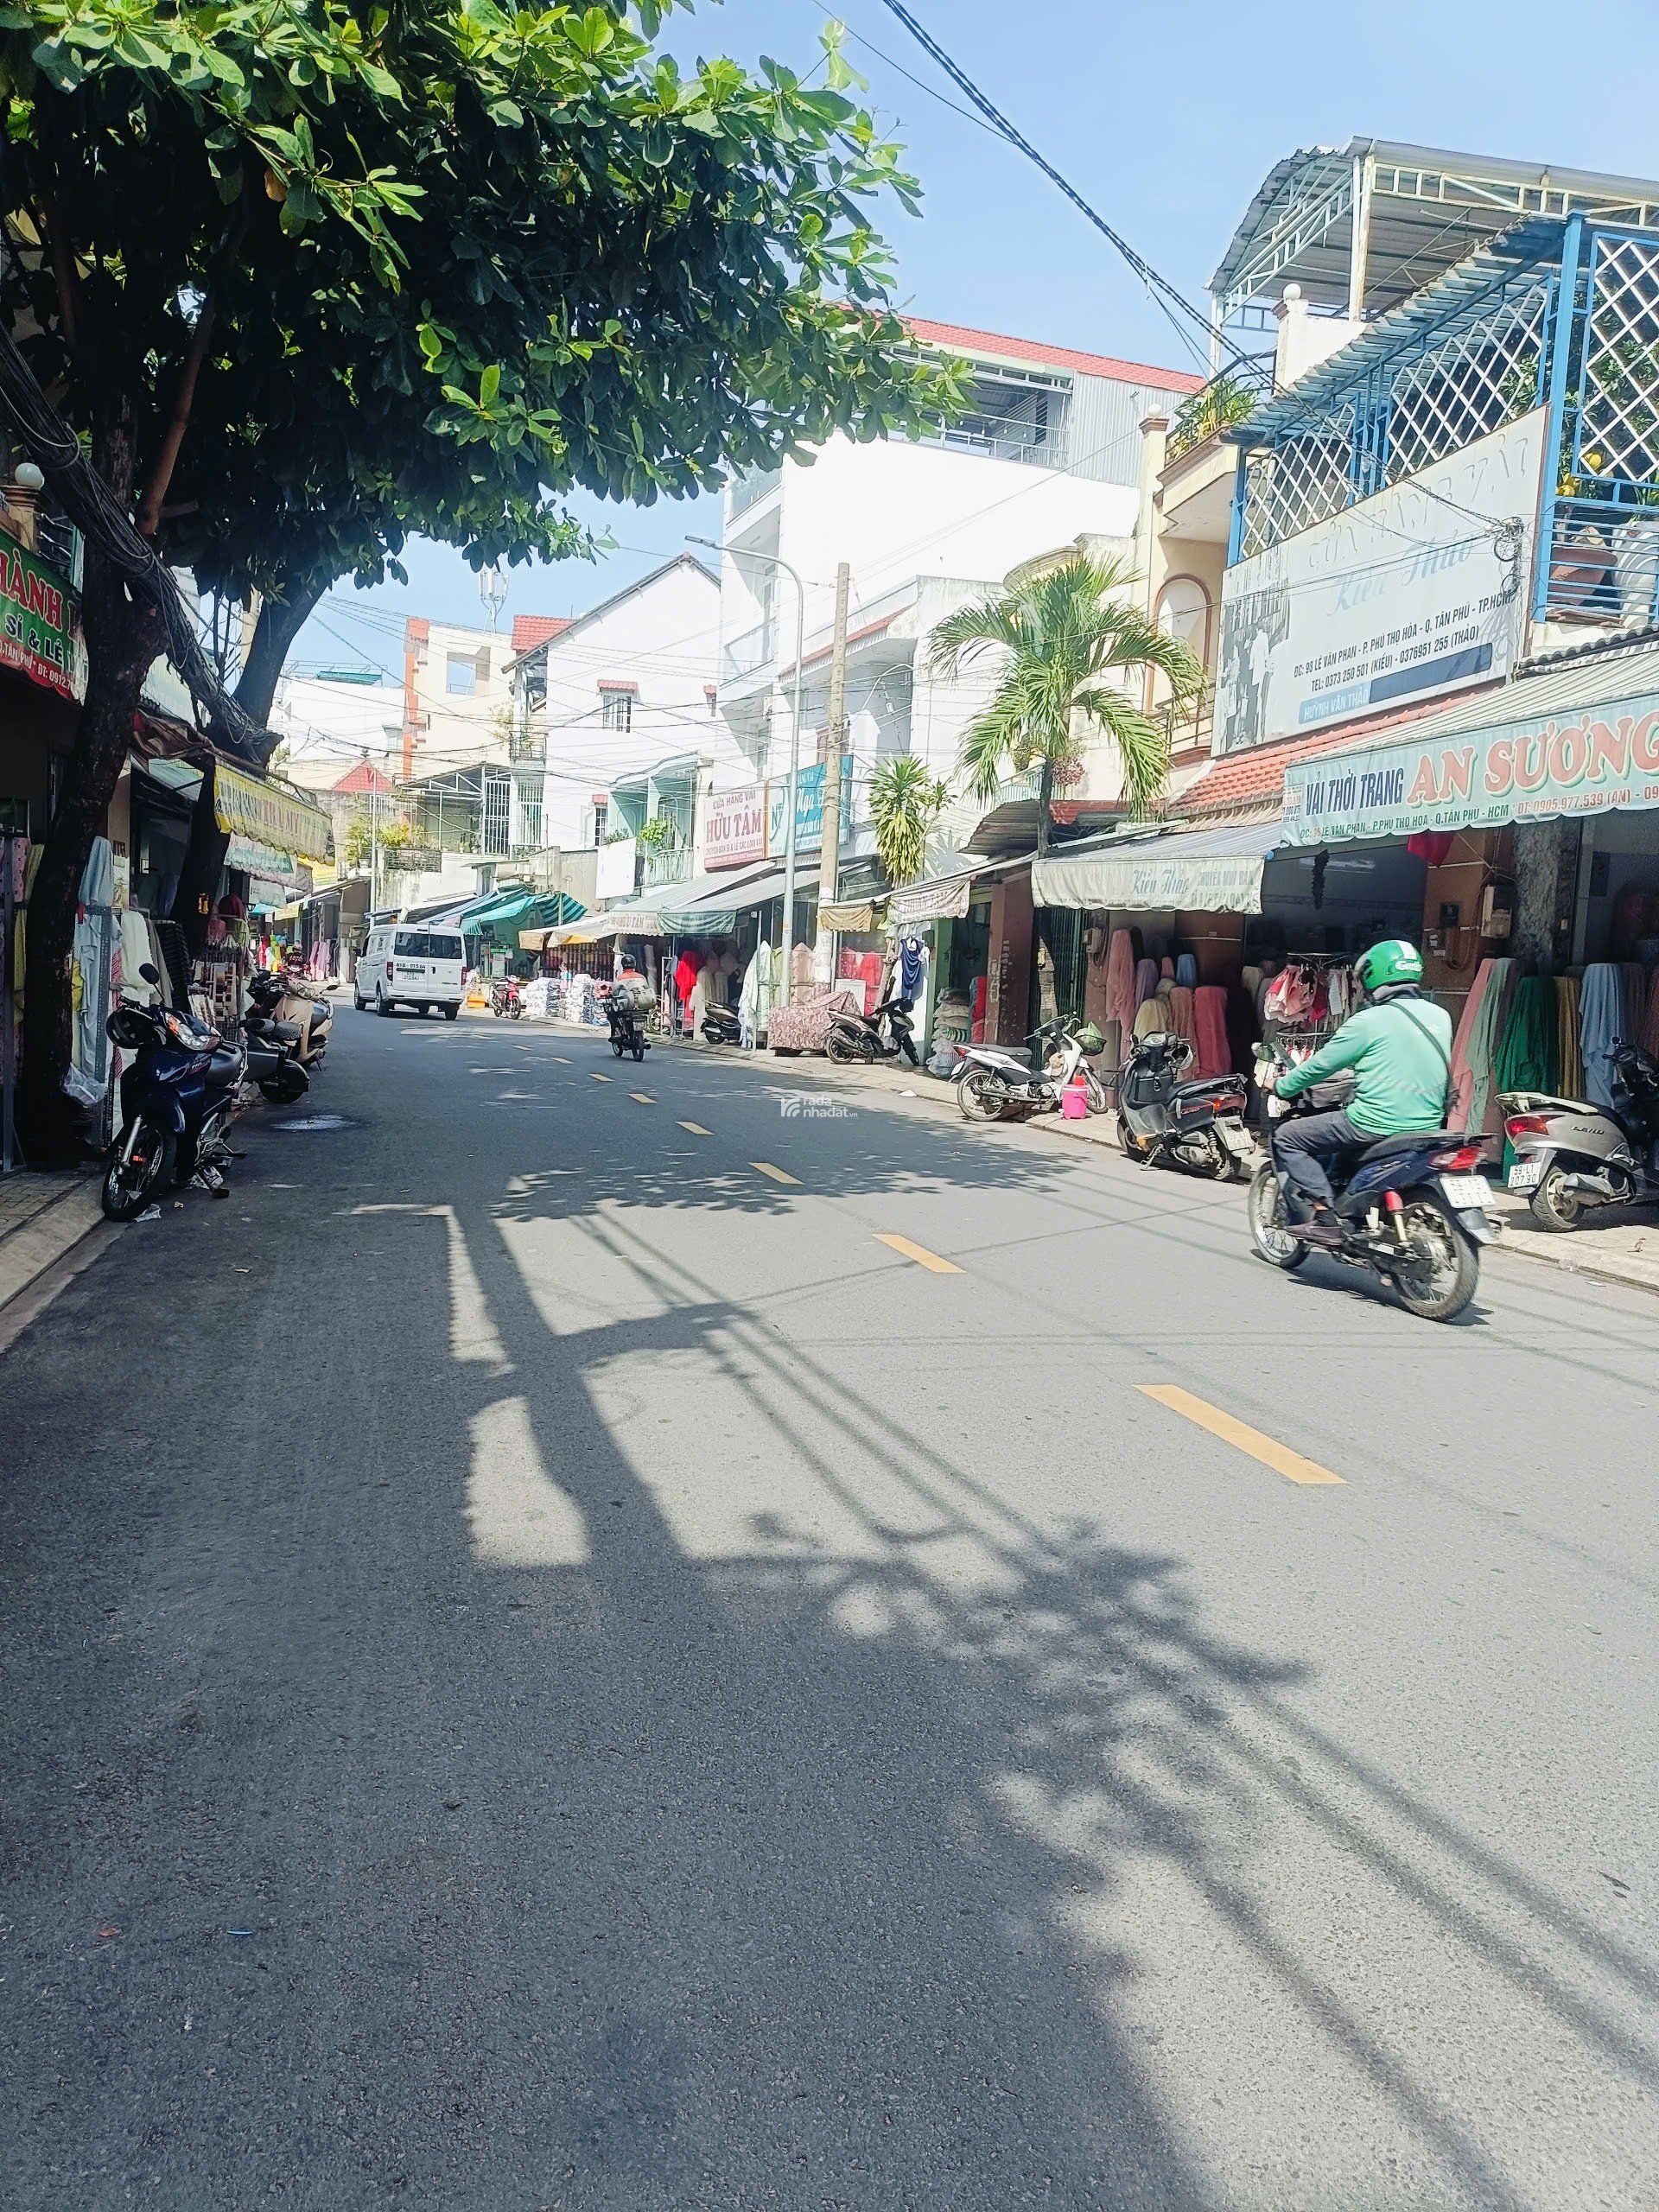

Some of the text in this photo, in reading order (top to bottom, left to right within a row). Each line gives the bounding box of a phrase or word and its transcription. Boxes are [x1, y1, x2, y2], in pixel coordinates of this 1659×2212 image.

[29, 628, 41, 654] &
[1338, 645, 1357, 663] PHAN
[1363, 641, 1369, 654] P.
[1370, 632, 1385, 652] PHÚ
[1387, 629, 1400, 646] THỌ
[1425, 619, 1432, 633] Q.
[1435, 610, 1451, 629] TÂN
[1452, 601, 1470, 622] PHÚ
[1312, 677, 1324, 692] TEL:
[1325, 671, 1341, 688] 0373
[1342, 667, 1355, 683] 250
[1356, 662, 1369, 677] 501
[1400, 641, 1431, 664] 0376951
[1434, 636, 1449, 653] 255
[1306, 711, 1659, 817] VẢI THỜI TRANG AN SƯƠNG
[1347, 822, 1366, 835] PHAN
[1488, 804, 1510, 818] HCM
[1533, 792, 1604, 813] 0905.977.539
[706, 812, 731, 843] HỮU
[734, 804, 762, 837] TÂM
[1571, 1125, 1605, 1135] LEAD
